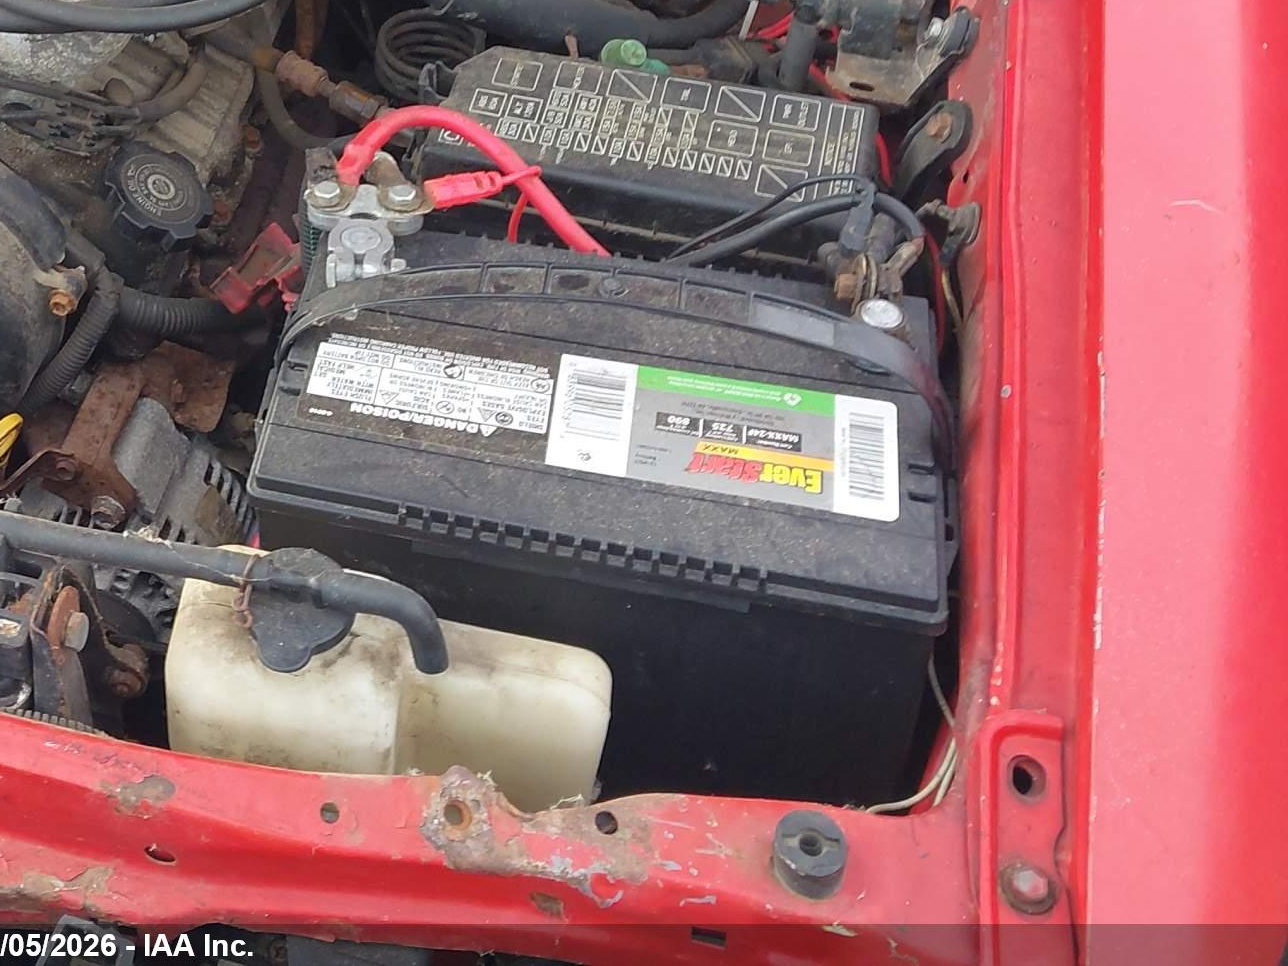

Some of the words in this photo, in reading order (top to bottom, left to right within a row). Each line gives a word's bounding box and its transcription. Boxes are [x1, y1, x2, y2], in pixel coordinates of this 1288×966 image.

[325, 381, 374, 394] IMMEDIATELY
[348, 402, 479, 433] DANGER/POISON
[701, 442, 739, 456] MAXX
[683, 450, 823, 495] EverStart
